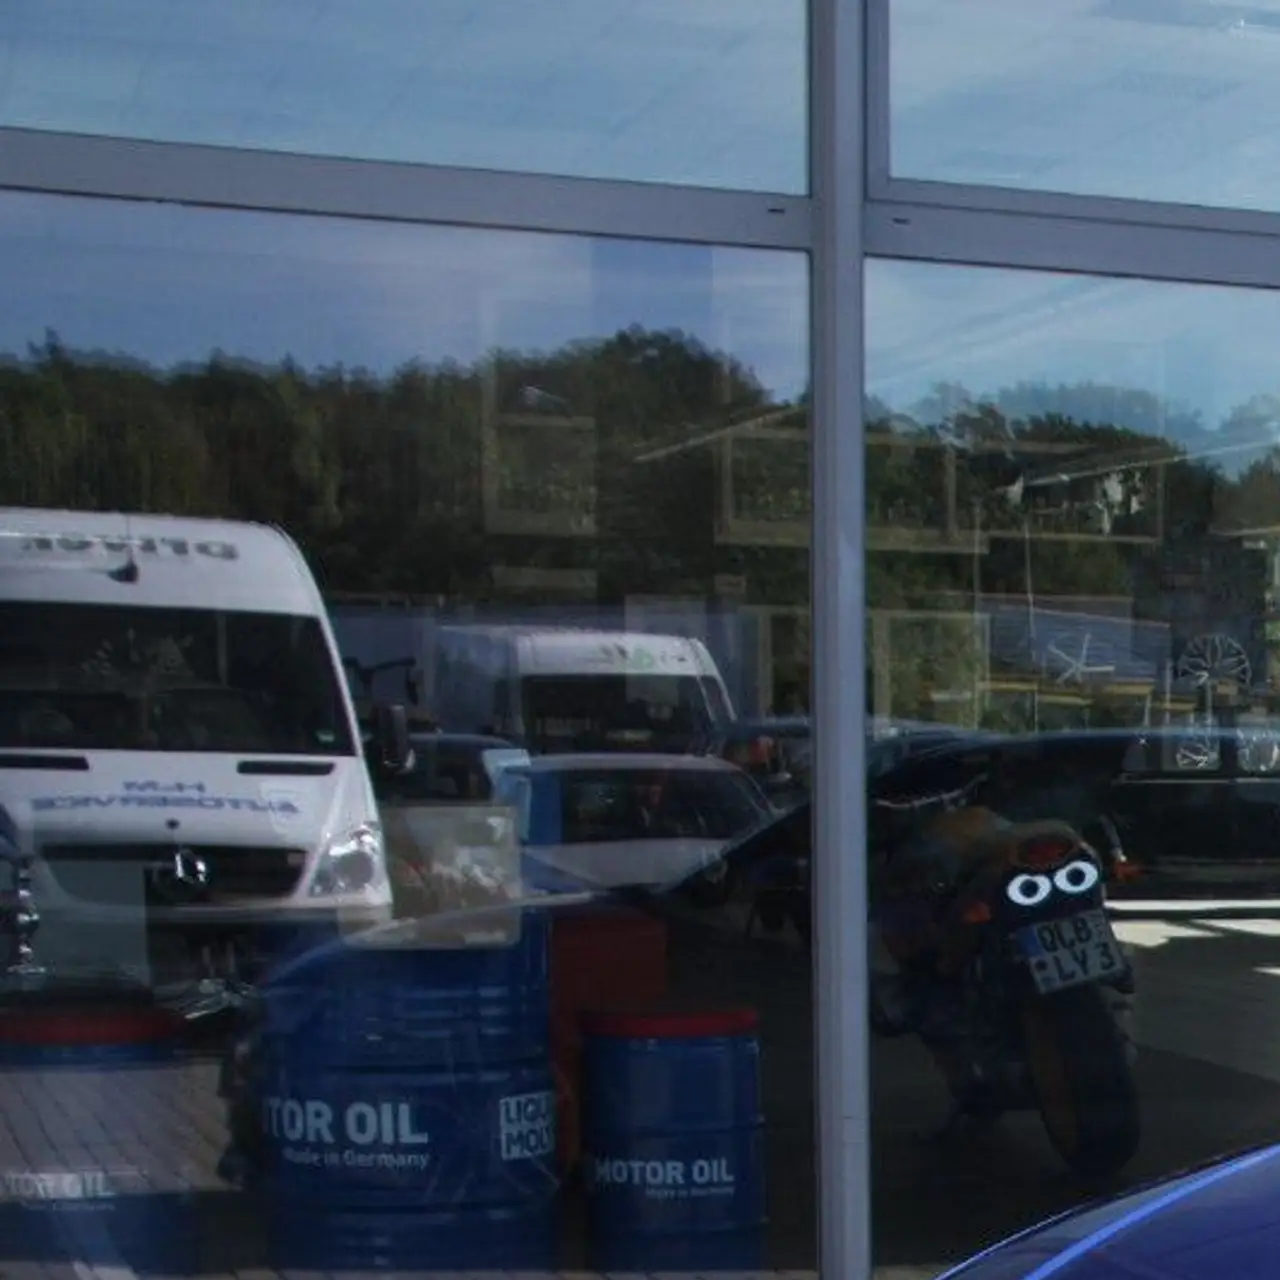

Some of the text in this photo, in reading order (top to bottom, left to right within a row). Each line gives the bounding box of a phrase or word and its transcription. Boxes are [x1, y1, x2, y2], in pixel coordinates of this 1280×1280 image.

[262, 1098, 429, 1145] TOR OIL
[343, 1148, 429, 1171] Germany
[596, 1157, 735, 1185] MOTOR OIL
